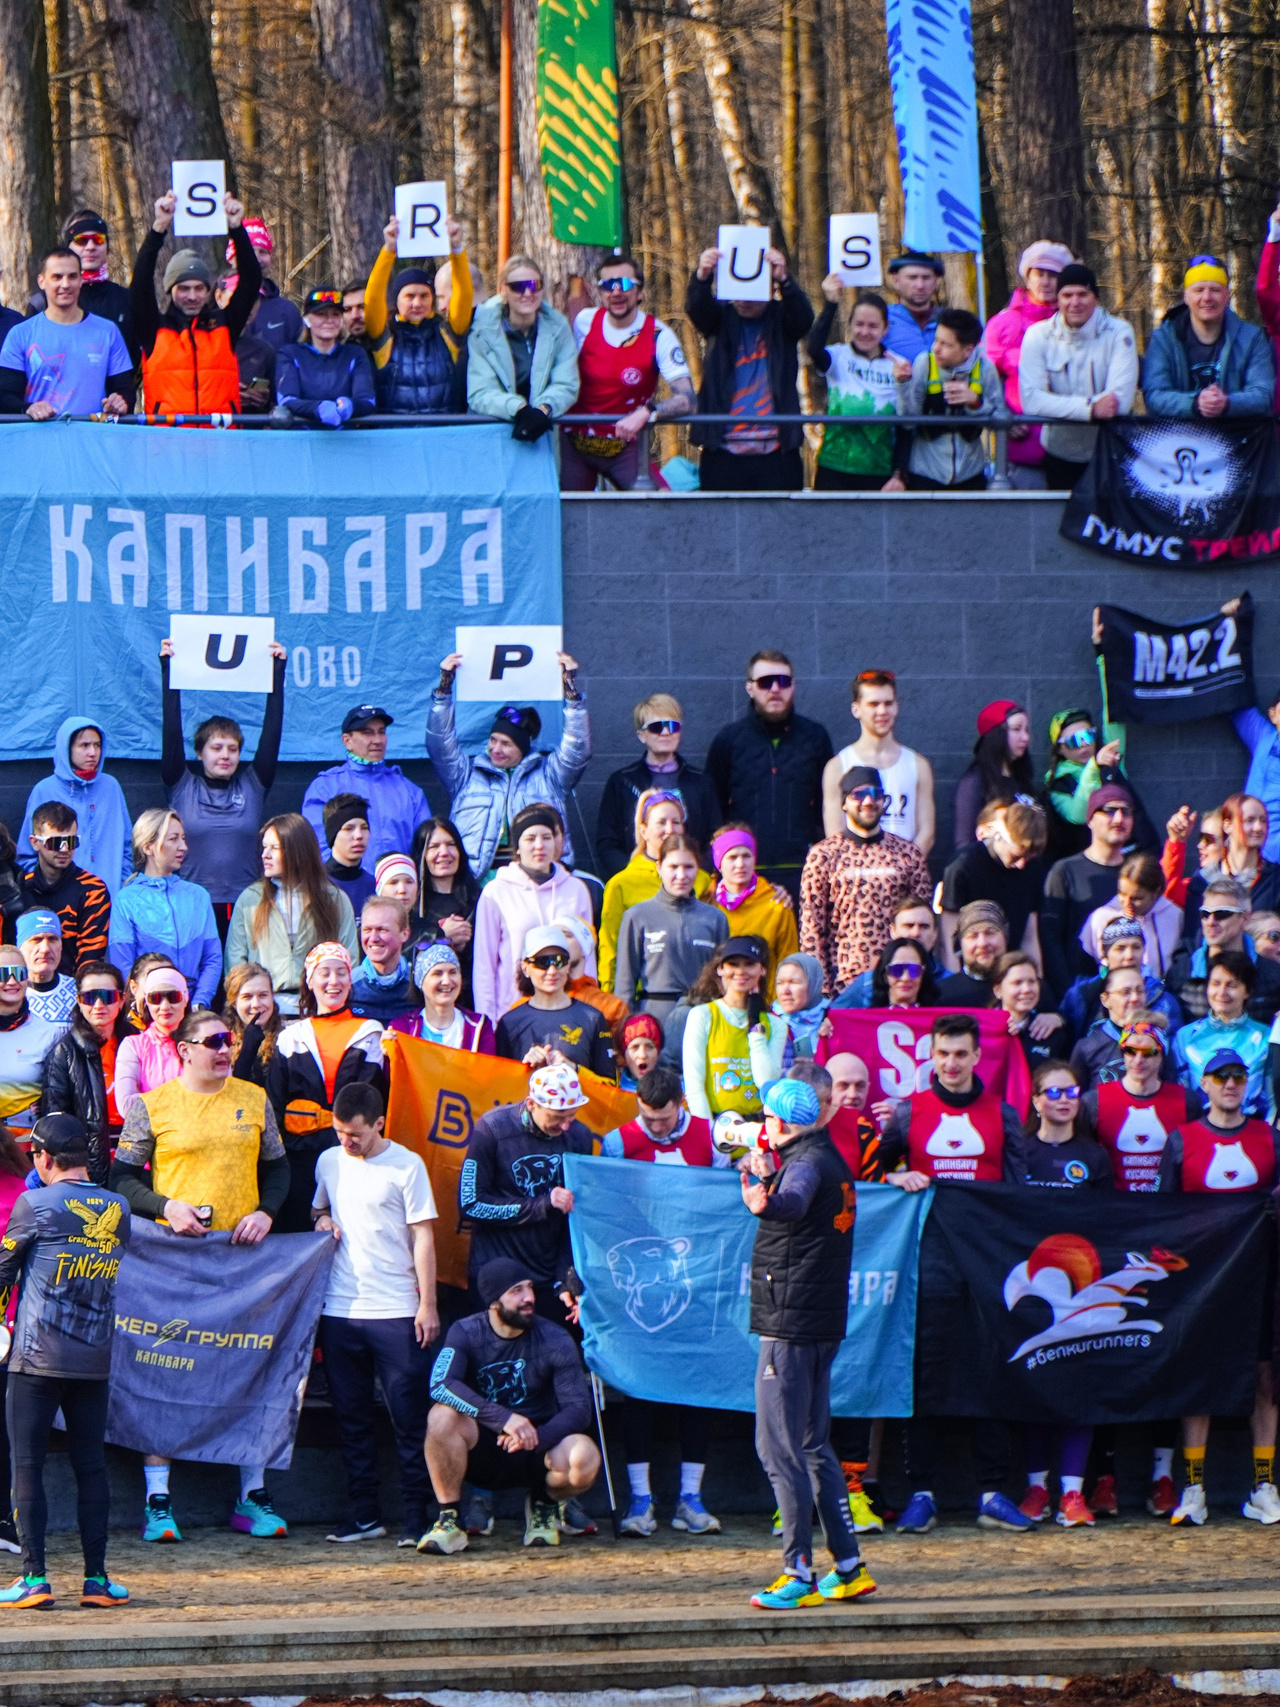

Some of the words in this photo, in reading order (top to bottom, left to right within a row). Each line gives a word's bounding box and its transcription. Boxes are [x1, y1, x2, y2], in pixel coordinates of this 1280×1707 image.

[186, 181, 217, 217] S
[410, 203, 442, 238] R
[729, 246, 765, 282] U
[840, 235, 872, 269] S
[1082, 513, 1184, 561] ГУМУС
[49, 503, 505, 614] КАПИБАРА
[204, 633, 249, 670] U
[489, 643, 534, 681] P
[1133, 615, 1242, 683] M42.2
[710, 1056, 751, 1064] NEVE
[114, 1314, 159, 1336] КЕР
[185, 1329, 275, 1350] ГРУППА
